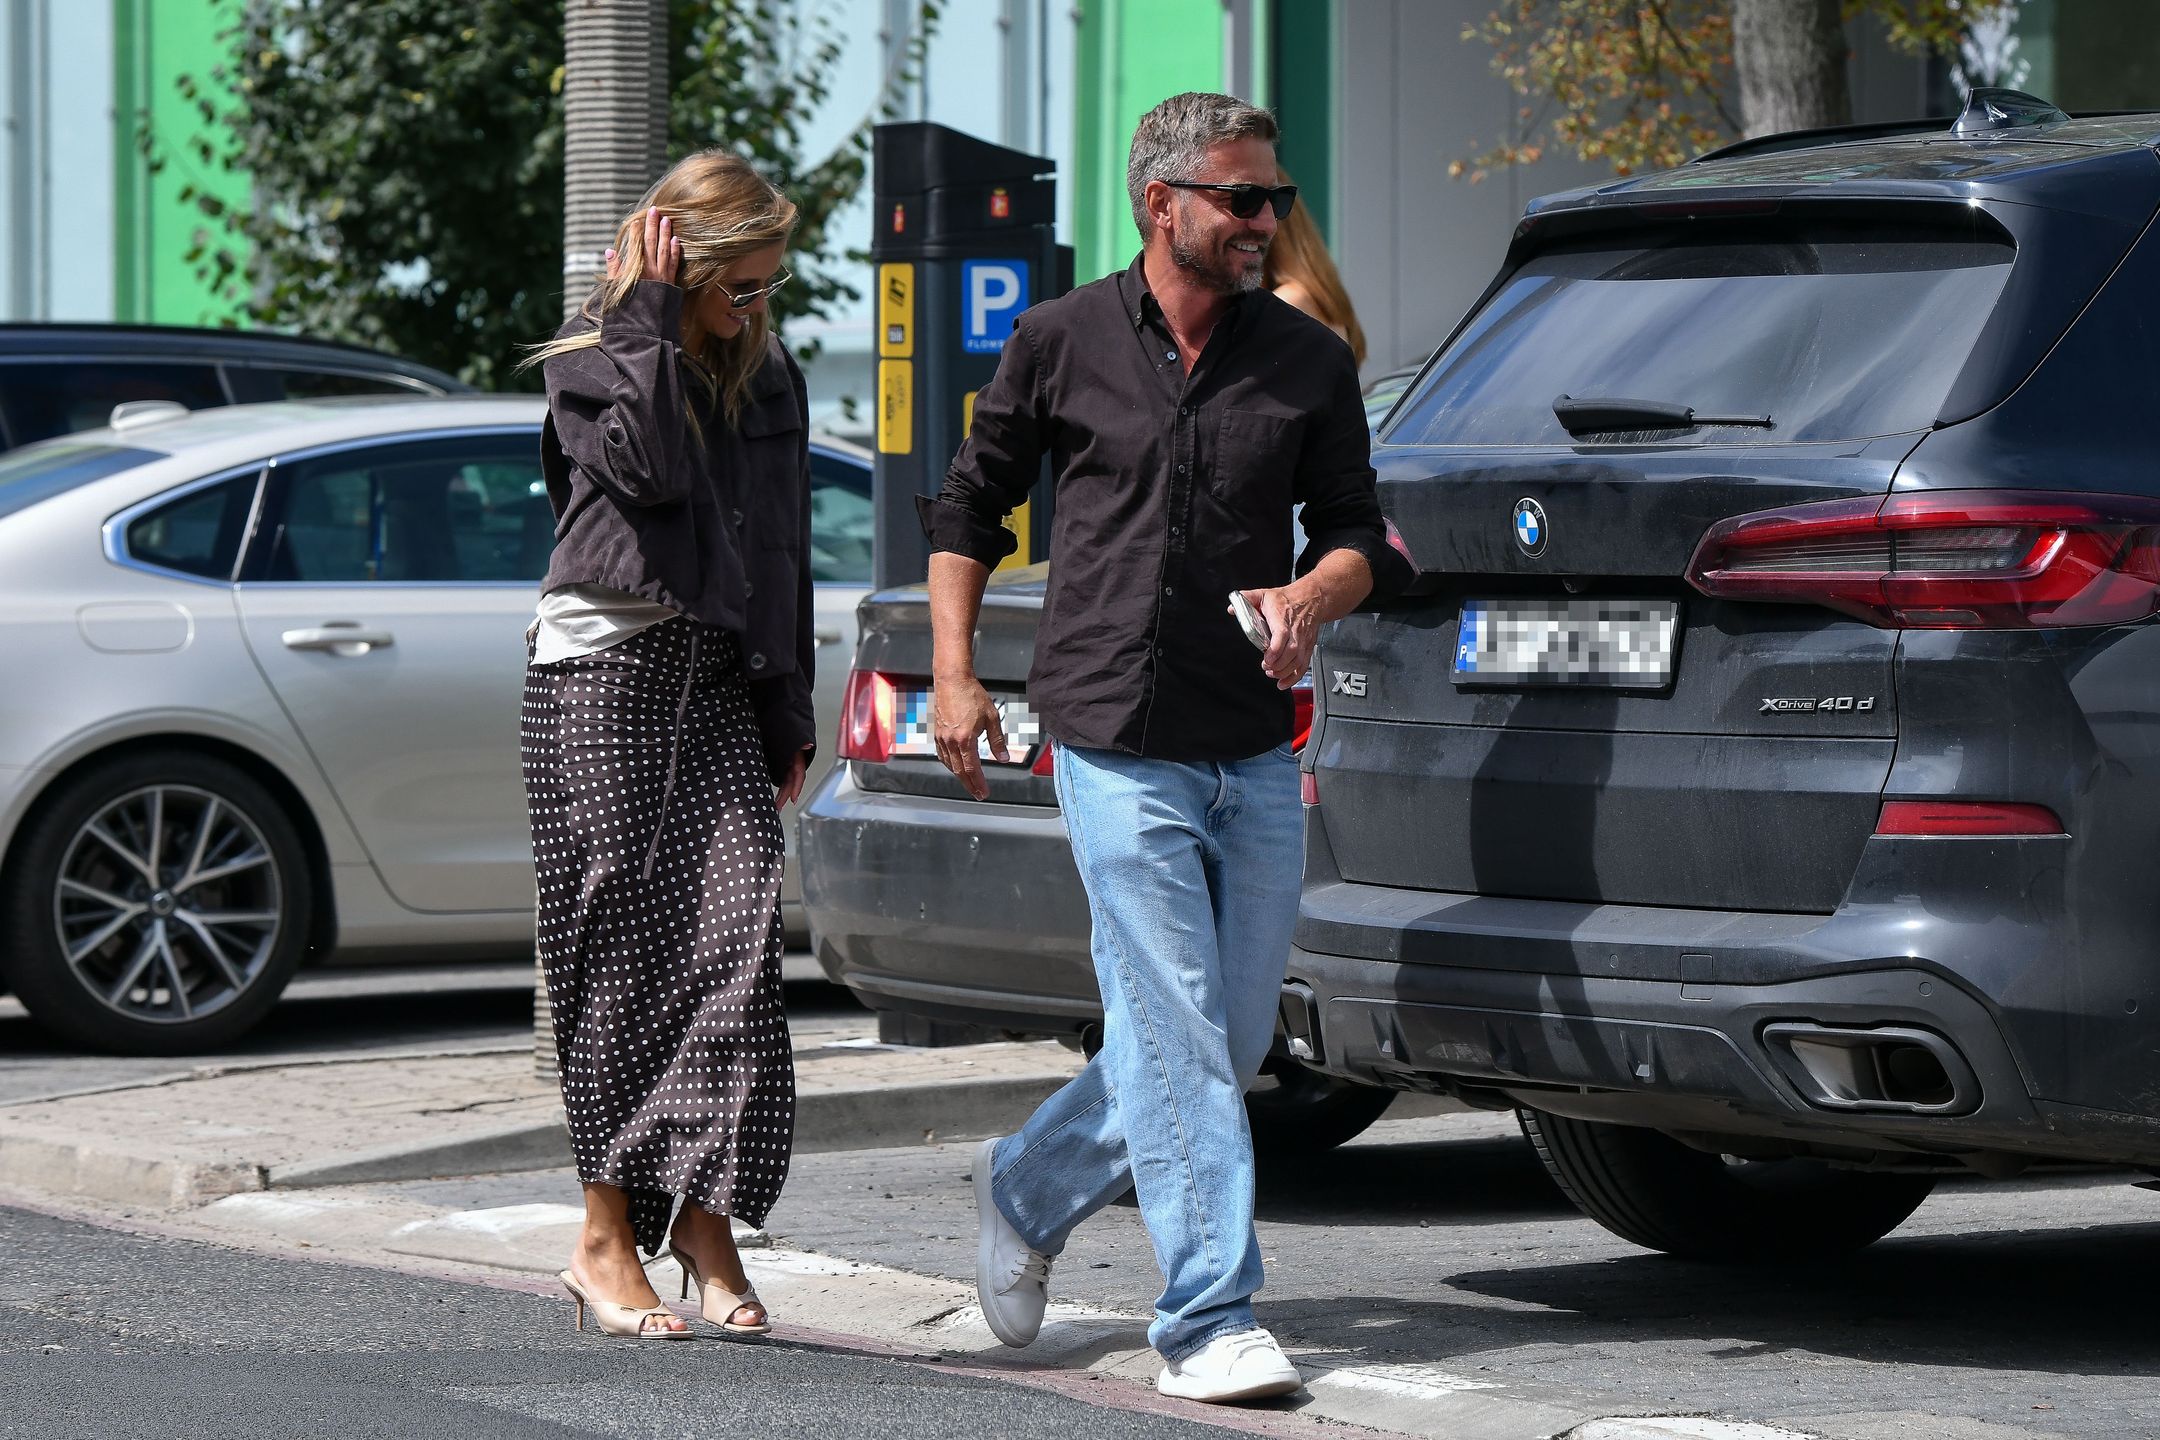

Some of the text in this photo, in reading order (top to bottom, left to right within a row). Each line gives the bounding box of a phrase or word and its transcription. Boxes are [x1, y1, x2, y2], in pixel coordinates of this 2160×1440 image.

[971, 266, 1020, 336] P
[1514, 500, 1542, 519] BMW
[1331, 670, 1367, 697] X5
